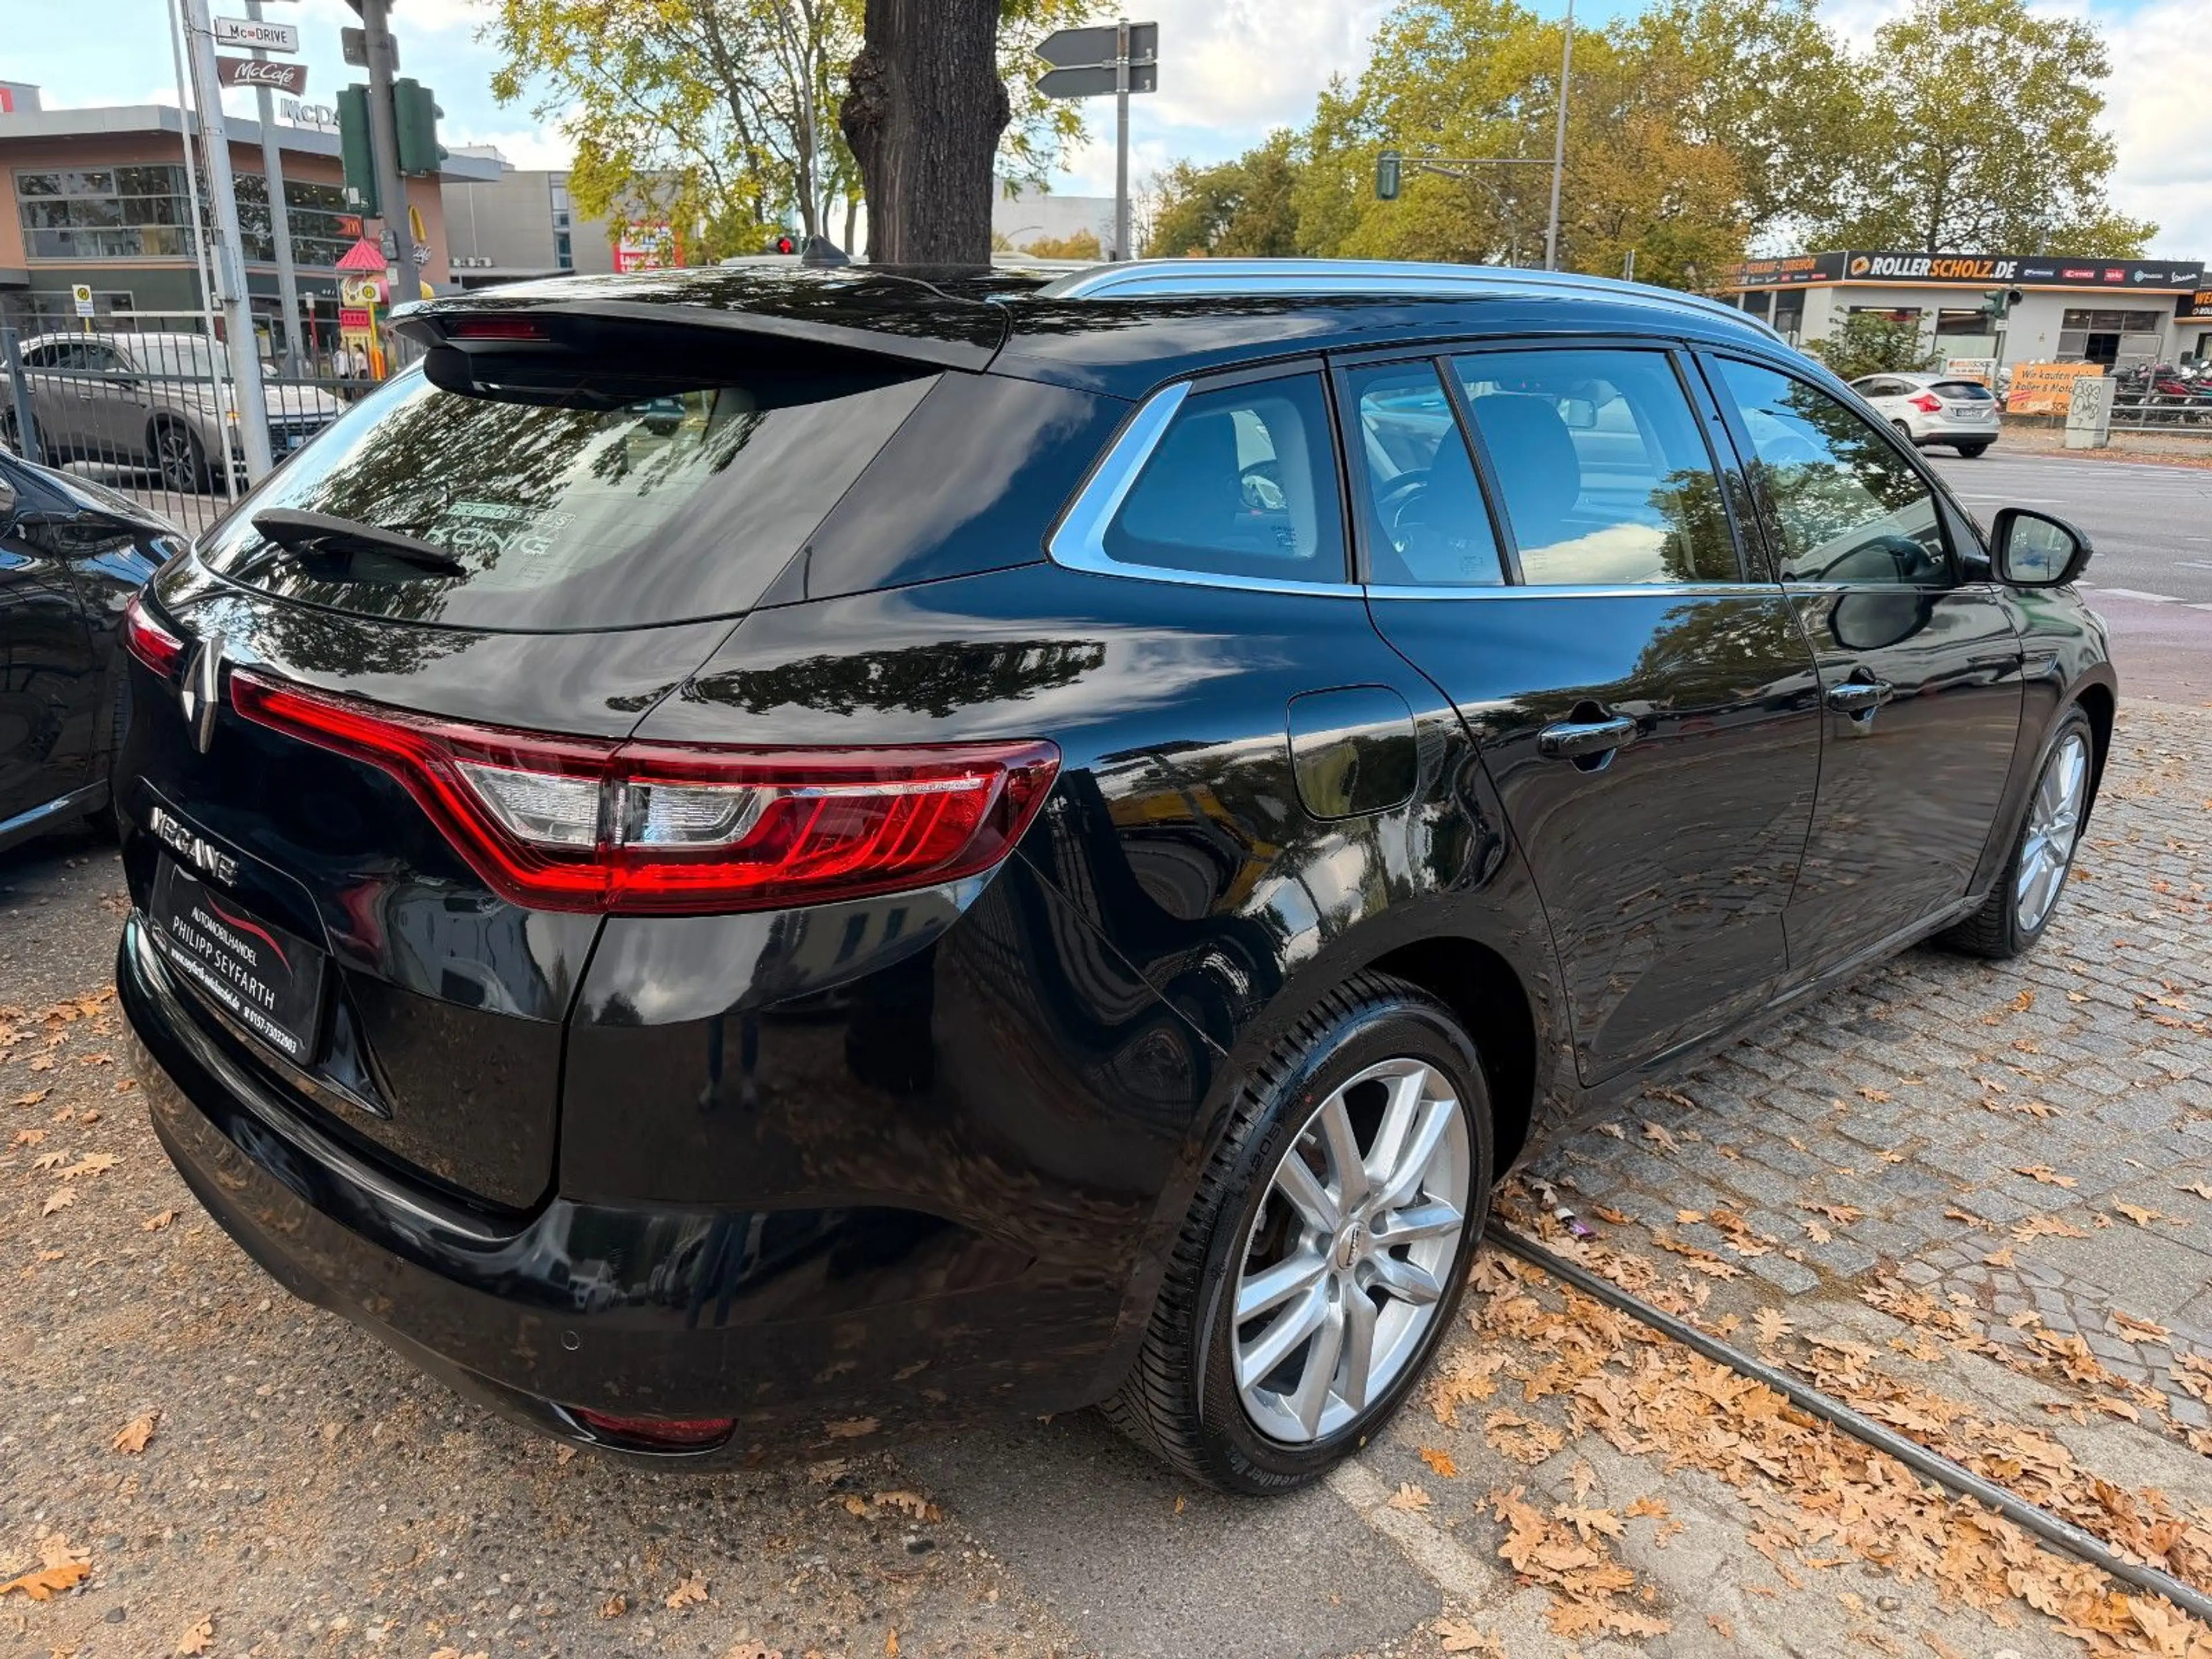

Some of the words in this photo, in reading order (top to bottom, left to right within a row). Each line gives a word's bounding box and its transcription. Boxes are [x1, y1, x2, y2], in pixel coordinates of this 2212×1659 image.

[256, 28, 287, 44] DRIVE
[1870, 257, 2018, 279] ROLLERSCHOLZ.DE
[2022, 369, 2037, 380] Wir
[2039, 369, 2070, 380] kaufen
[150, 807, 238, 887] MEGANE
[191, 906, 257, 967] AUTOMOBILHANDEL
[173, 915, 213, 959] PHILIPP
[214, 949, 275, 1010] SEYFARTH
